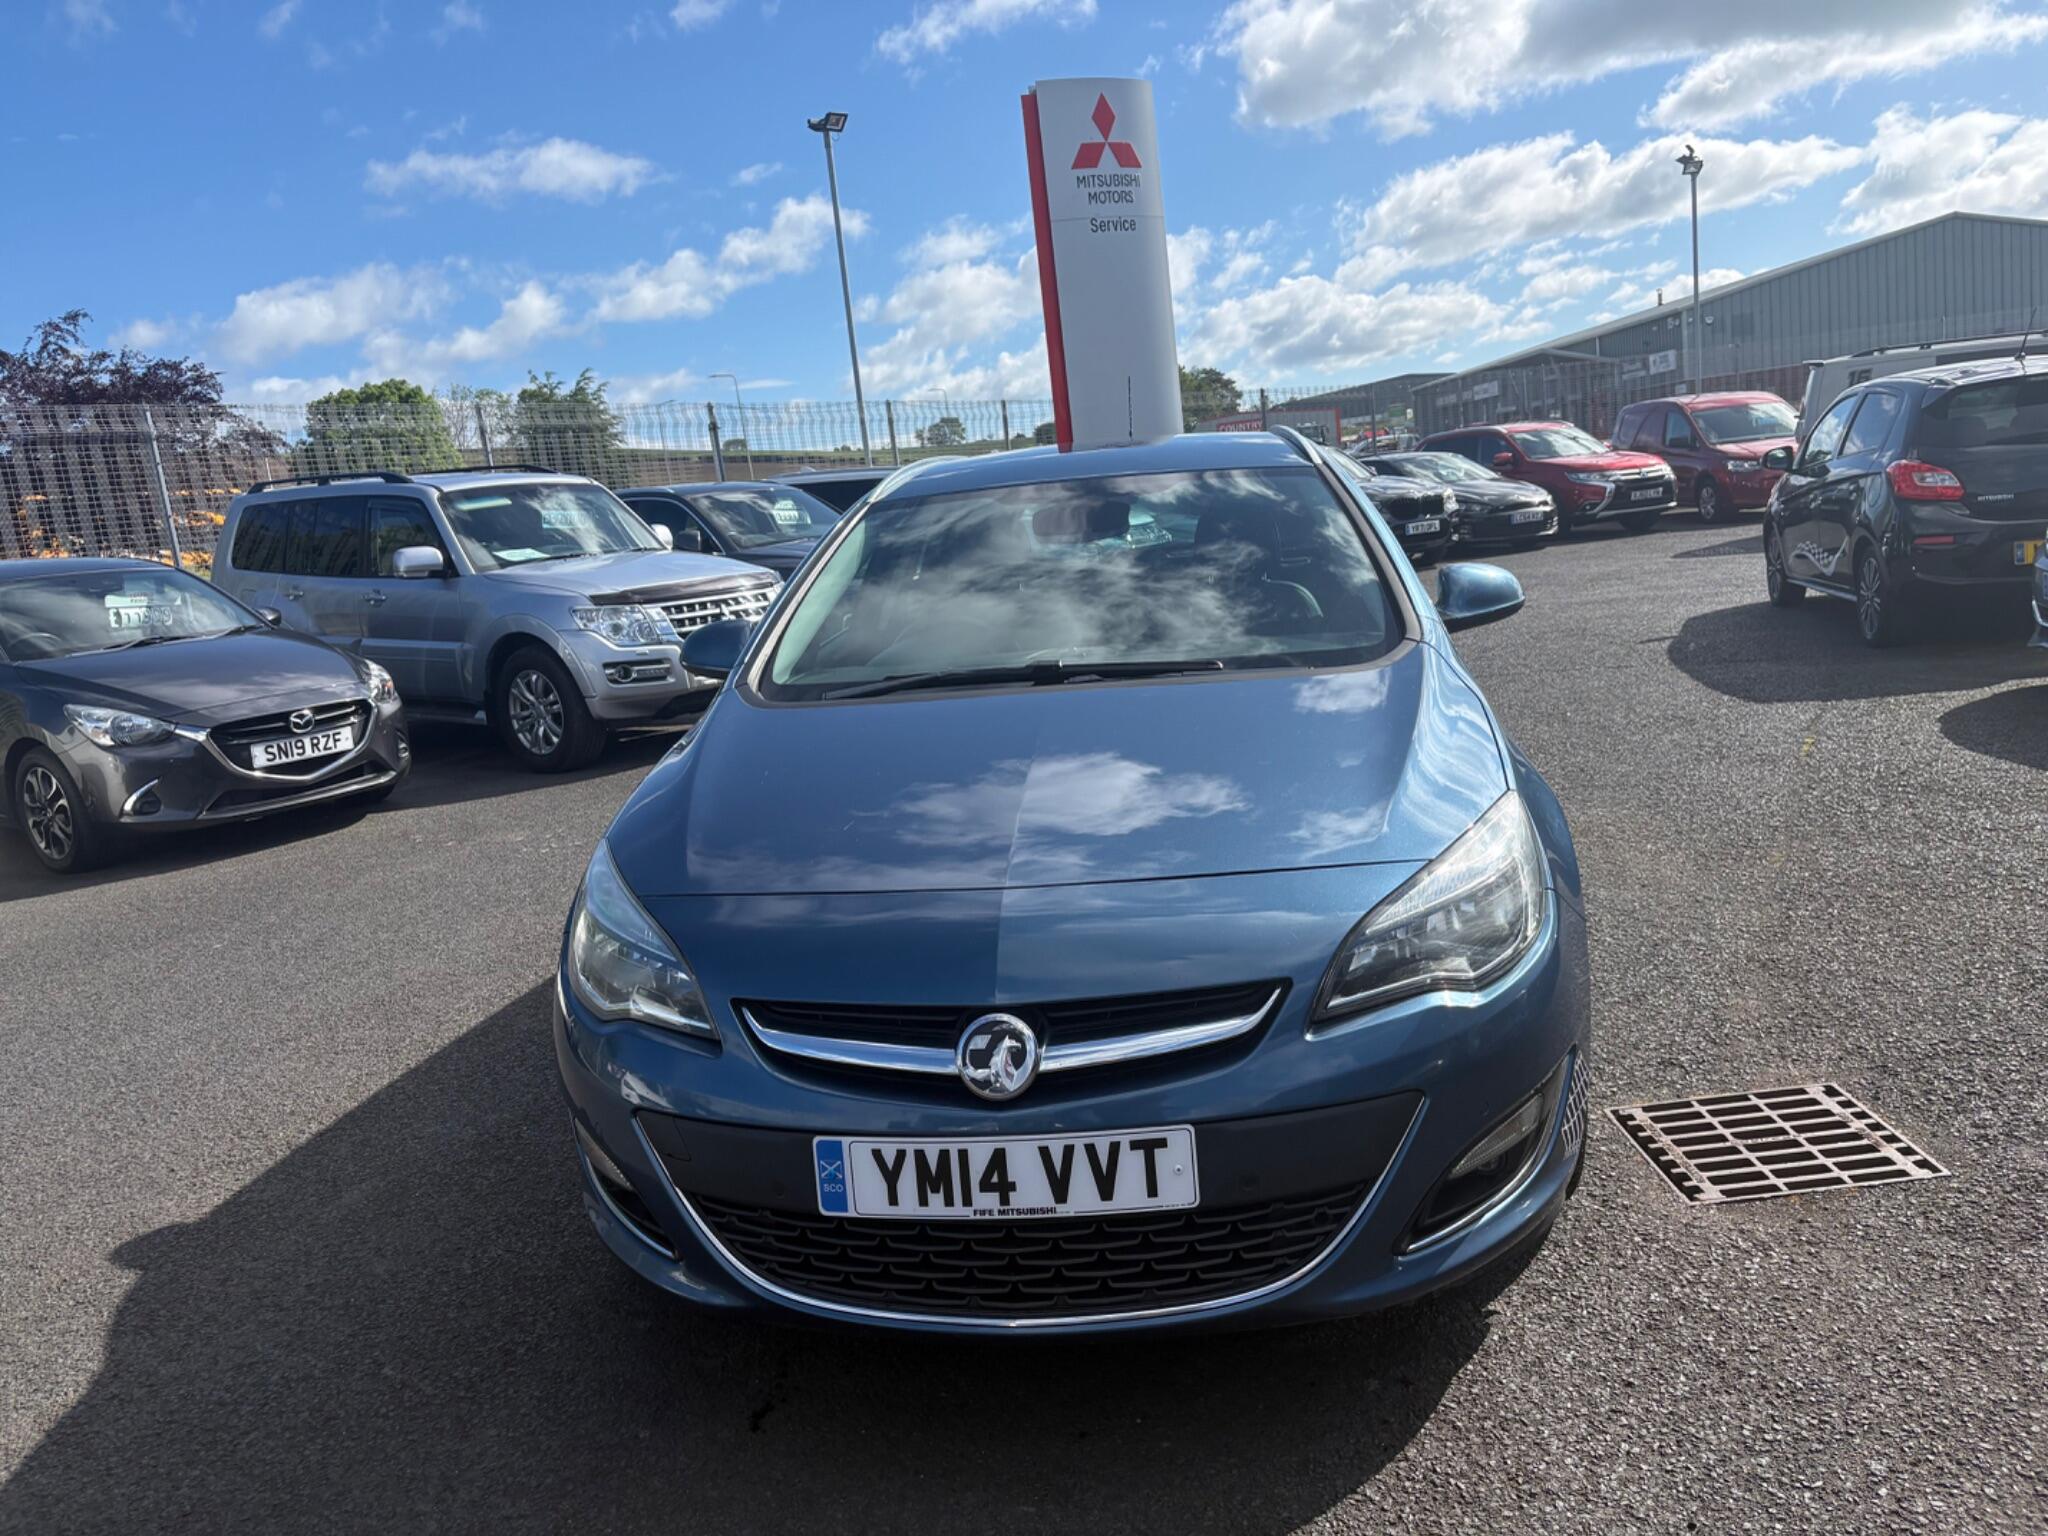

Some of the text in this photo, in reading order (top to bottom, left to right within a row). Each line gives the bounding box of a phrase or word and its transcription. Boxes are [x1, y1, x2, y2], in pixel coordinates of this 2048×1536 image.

[1076, 174, 1140, 189] MITSUBISHI
[1088, 190, 1134, 205] MOTORS
[1090, 216, 1137, 233] Service
[264, 731, 342, 762] SN19 RZF
[871, 1137, 1168, 1208] YM14 VVT
[824, 1183, 844, 1193] SCO
[973, 1206, 1057, 1217] FIFE MITSUBISHI
